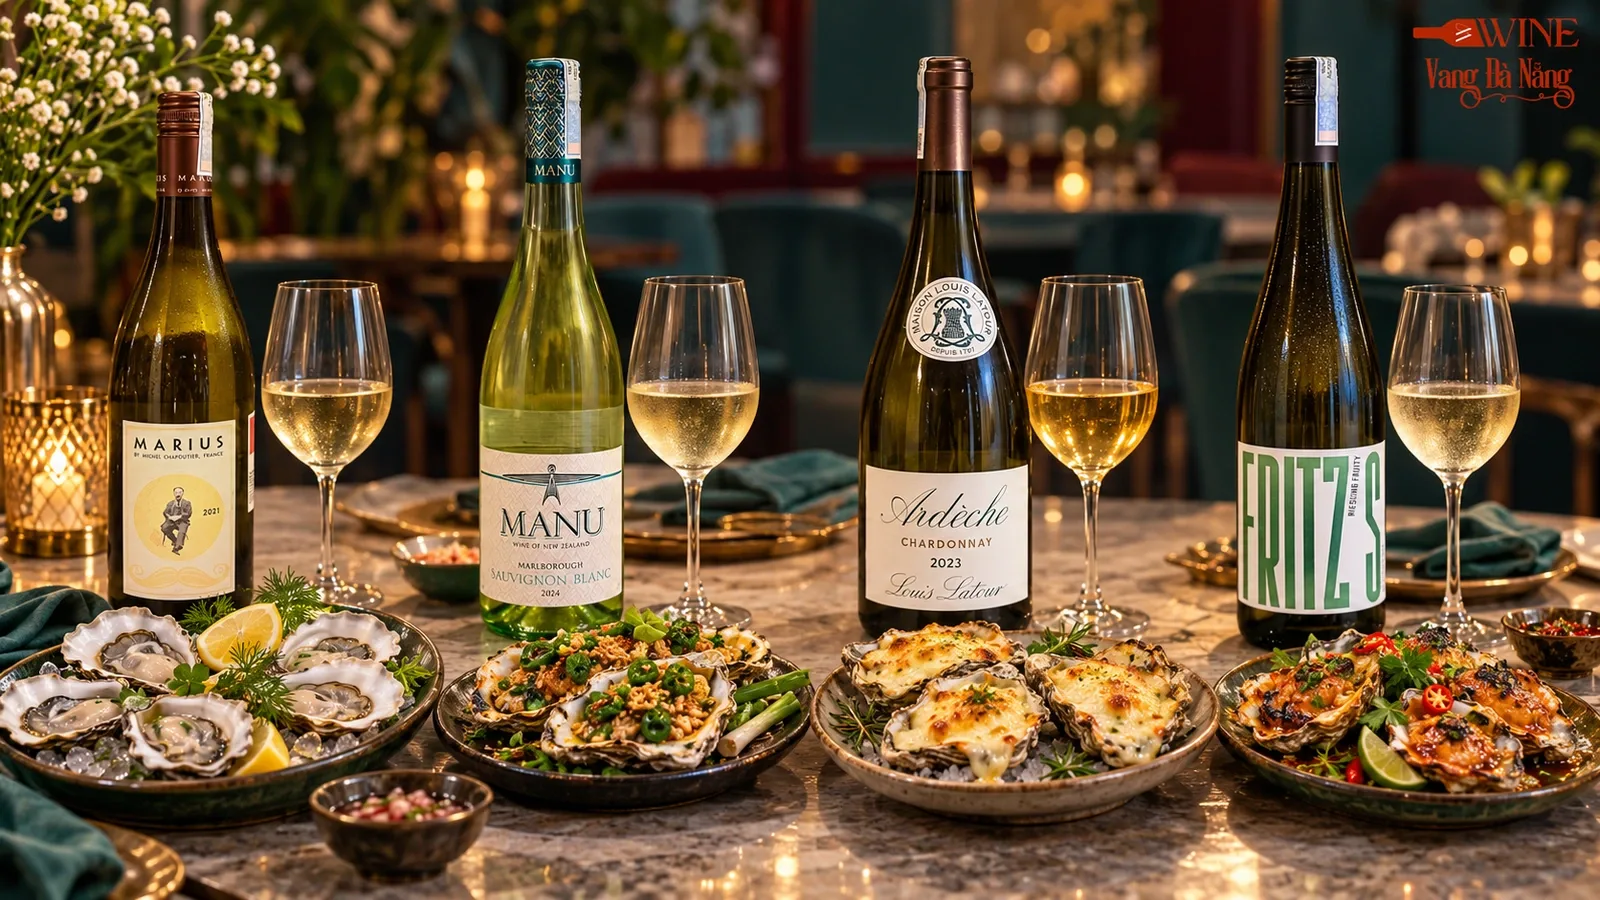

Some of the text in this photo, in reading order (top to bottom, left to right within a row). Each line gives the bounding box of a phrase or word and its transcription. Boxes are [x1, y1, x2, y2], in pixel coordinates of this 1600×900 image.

[535, 164, 575, 176] MANU
[912, 283, 992, 335] MAISON LOUIS LATOUR
[931, 346, 957, 355] DEPUIS
[134, 436, 223, 451] MARIUS
[203, 508, 220, 516] 2021
[880, 484, 1009, 529] Ardèche
[501, 507, 605, 539] MANU
[901, 538, 992, 549] CHARDONNAY
[518, 561, 583, 570] MARLBOROUGH
[930, 558, 962, 568] 2023
[491, 568, 611, 586] SAUVIGNON BLANC
[885, 573, 1007, 600] Louis Latour
